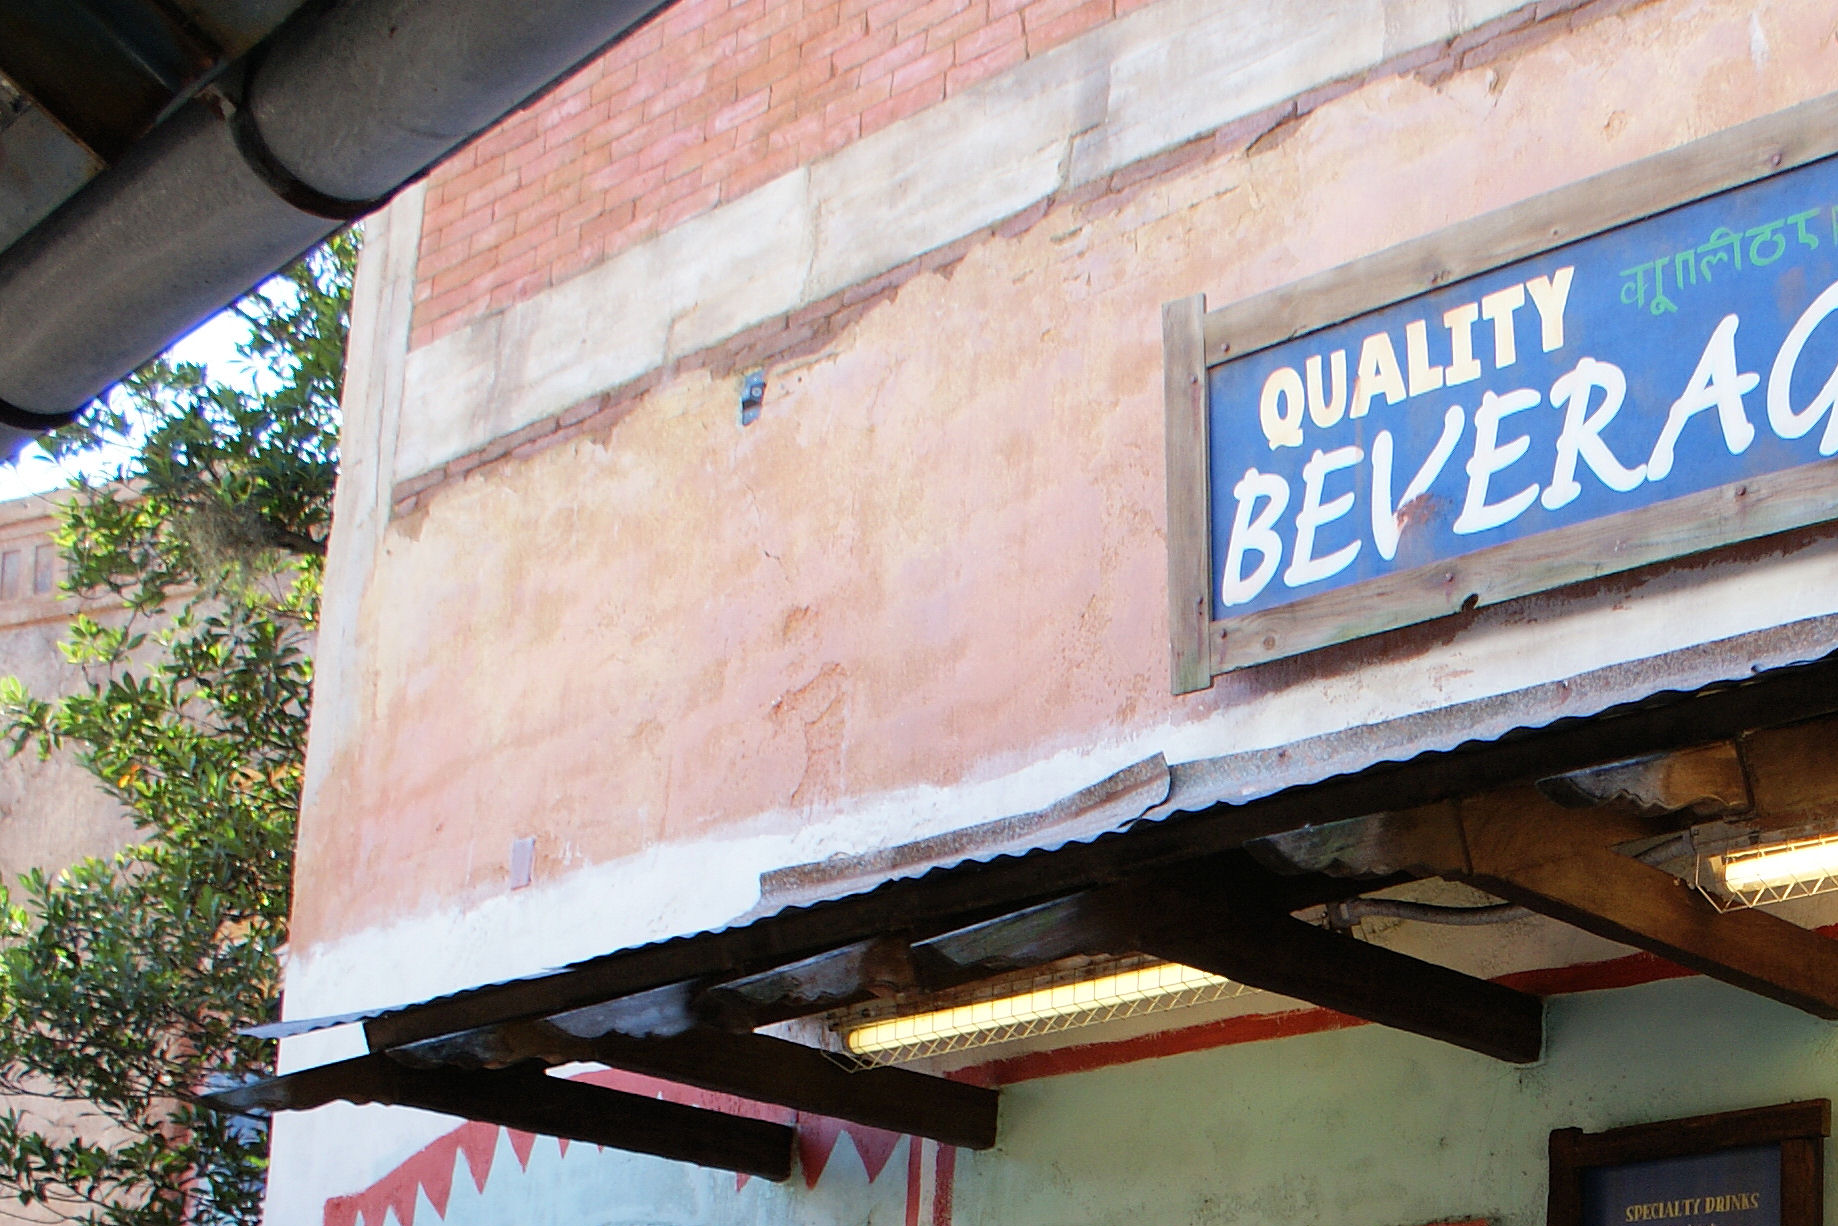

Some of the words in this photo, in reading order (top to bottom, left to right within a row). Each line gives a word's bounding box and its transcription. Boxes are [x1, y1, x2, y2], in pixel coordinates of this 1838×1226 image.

[1261, 265, 1575, 450] QUALITY
[1625, 1199, 1700, 1222] SPECIALTY
[1704, 1192, 1760, 1214] DRINKS
